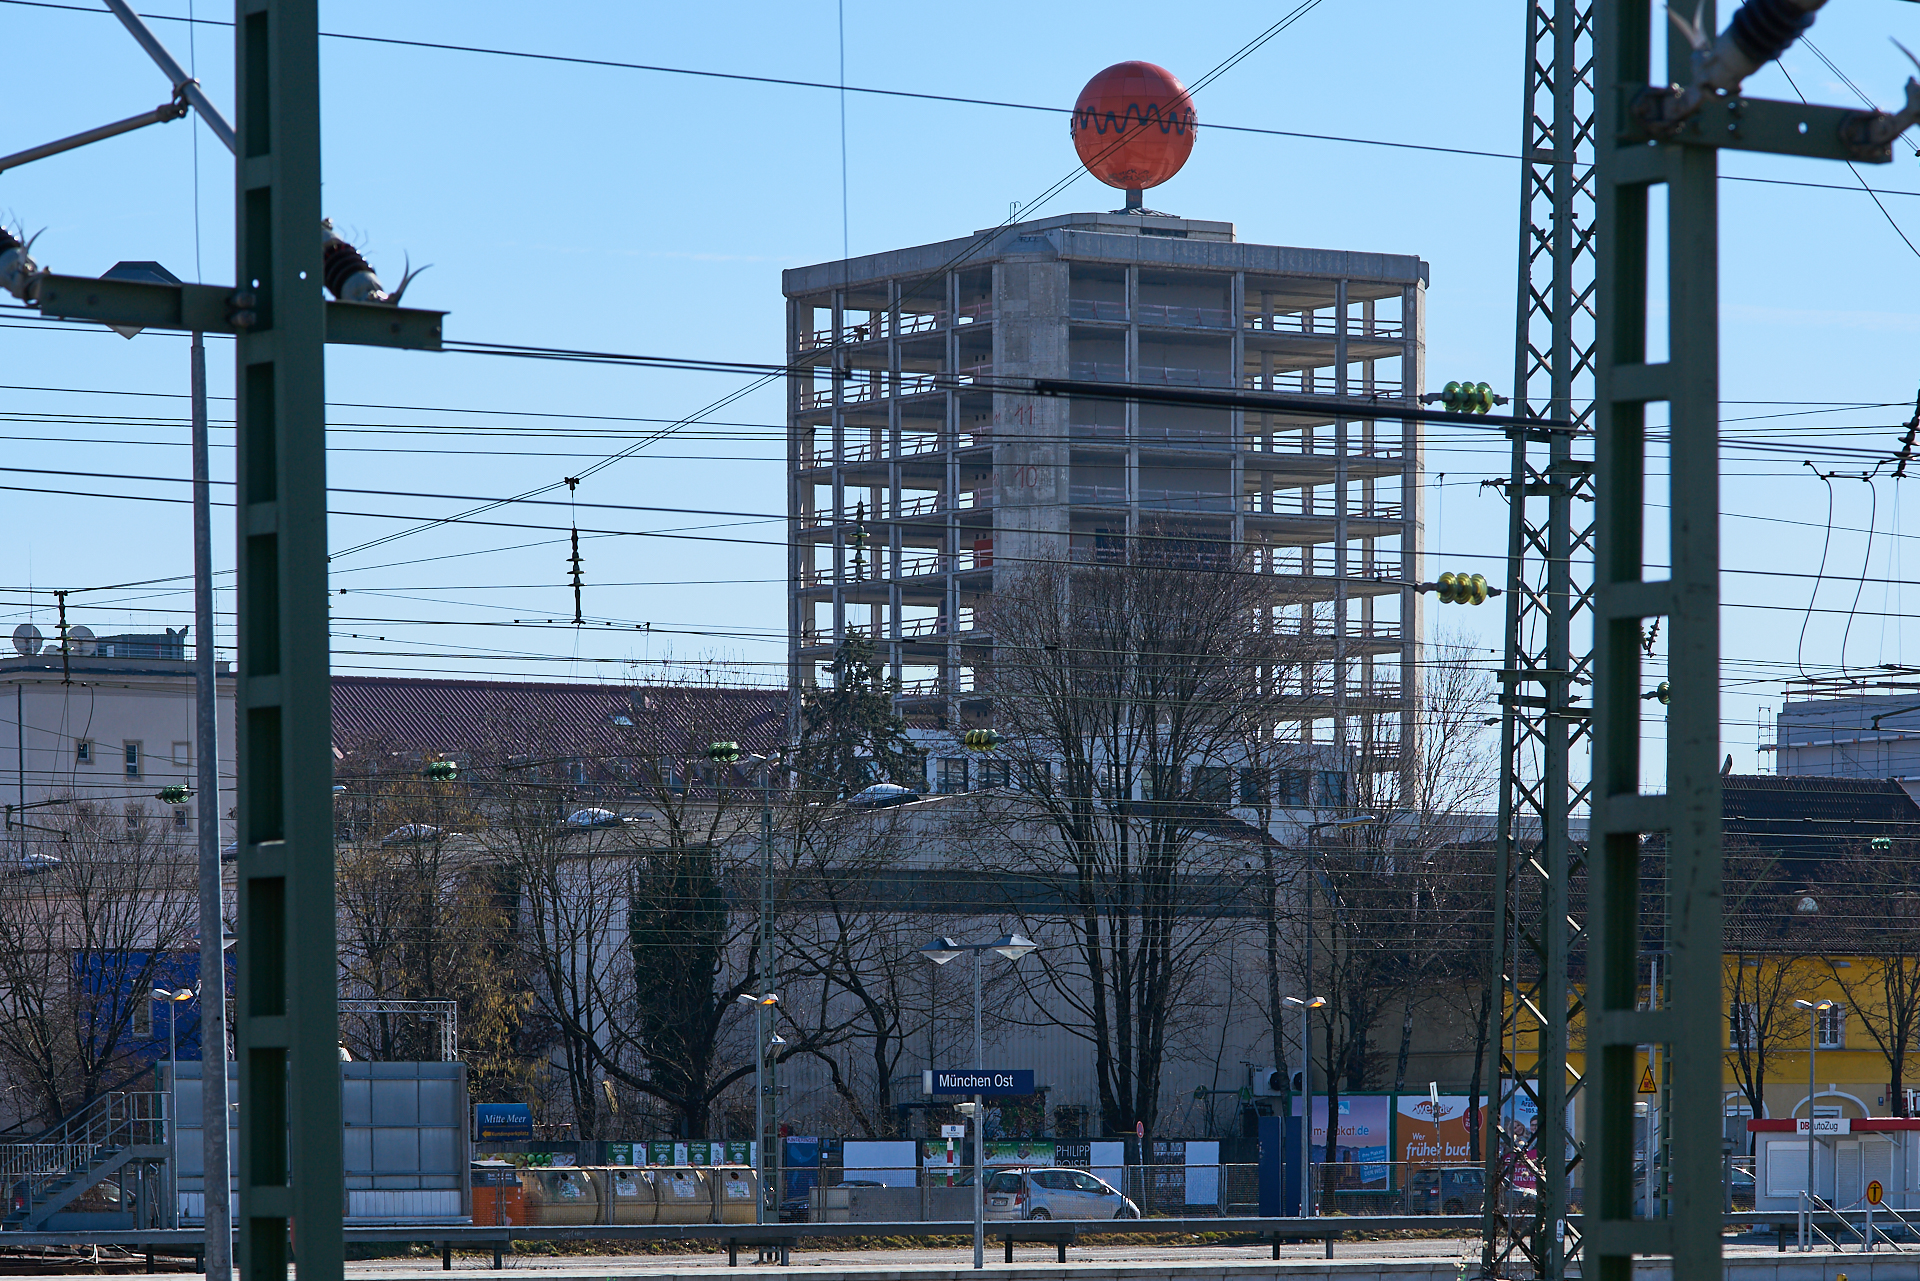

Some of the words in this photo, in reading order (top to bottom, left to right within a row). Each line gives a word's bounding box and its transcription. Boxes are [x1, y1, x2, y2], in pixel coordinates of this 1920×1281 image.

[1014, 405, 1033, 425] 11
[1014, 466, 1037, 488] 10
[939, 1074, 991, 1087] München
[994, 1073, 1014, 1087] Ost
[1415, 1104, 1451, 1118] wede
[484, 1114, 506, 1124] Mitte
[507, 1114, 527, 1123] Meer
[1313, 1125, 1369, 1136] m-akat.de
[1800, 1121, 1810, 1130] DB
[1813, 1121, 1838, 1132] utoZug
[491, 1130, 529, 1138] Kundenparkplatz
[1412, 1132, 1426, 1140] Wer
[1056, 1145, 1090, 1157] PHILIPP
[1445, 1142, 1471, 1157] buch
